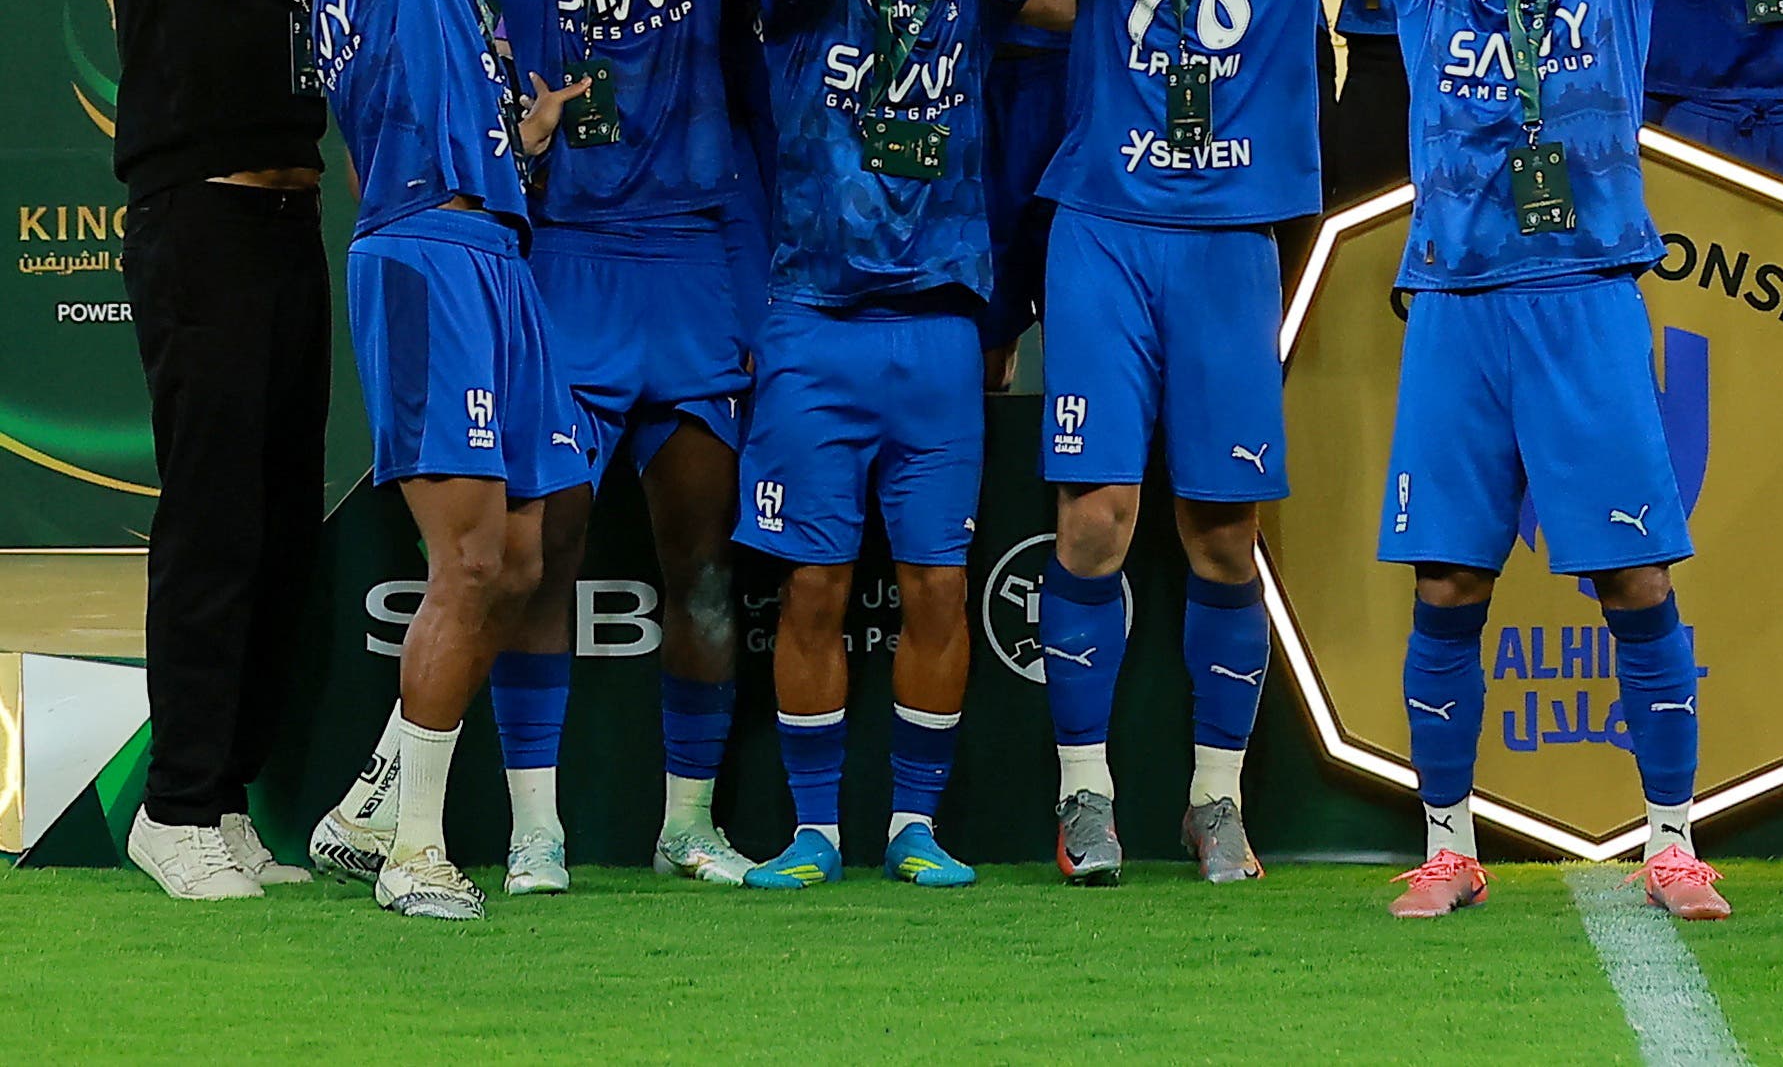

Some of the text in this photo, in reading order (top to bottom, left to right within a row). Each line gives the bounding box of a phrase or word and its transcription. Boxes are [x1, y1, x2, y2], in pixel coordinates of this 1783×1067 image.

[1445, 1, 1588, 80] SAY
[19, 249, 109, 275] الشريفين
[57, 303, 134, 322] POWER
[365, 580, 662, 657] SB
